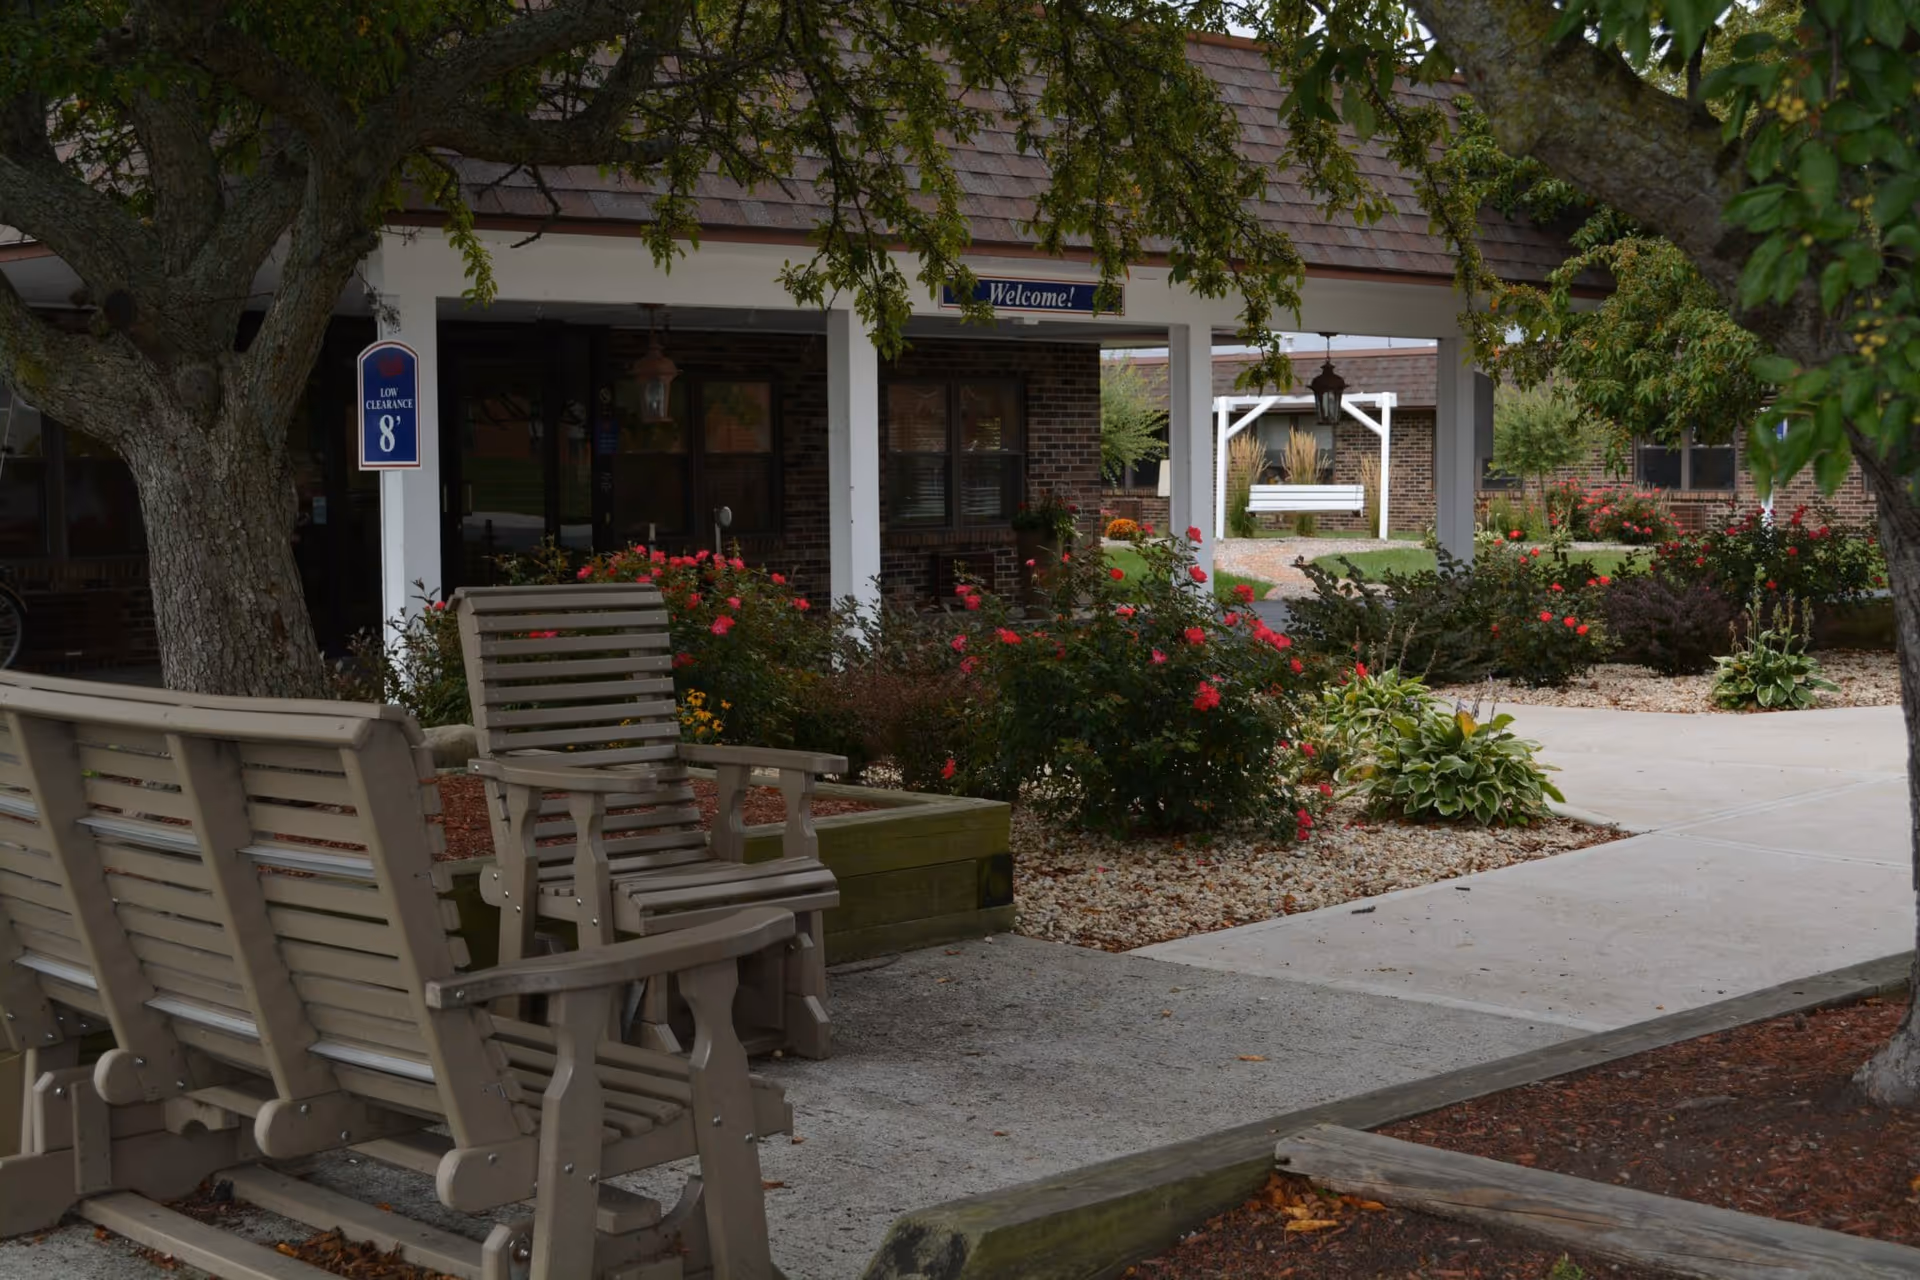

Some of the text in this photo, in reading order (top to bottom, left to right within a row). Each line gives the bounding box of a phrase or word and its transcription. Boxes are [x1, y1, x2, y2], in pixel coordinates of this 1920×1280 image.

[990, 283, 1075, 307] Welcome!
[380, 387, 398, 398] LOW
[366, 399, 413, 410] CLEARANCE
[379, 414, 401, 453] 8'
